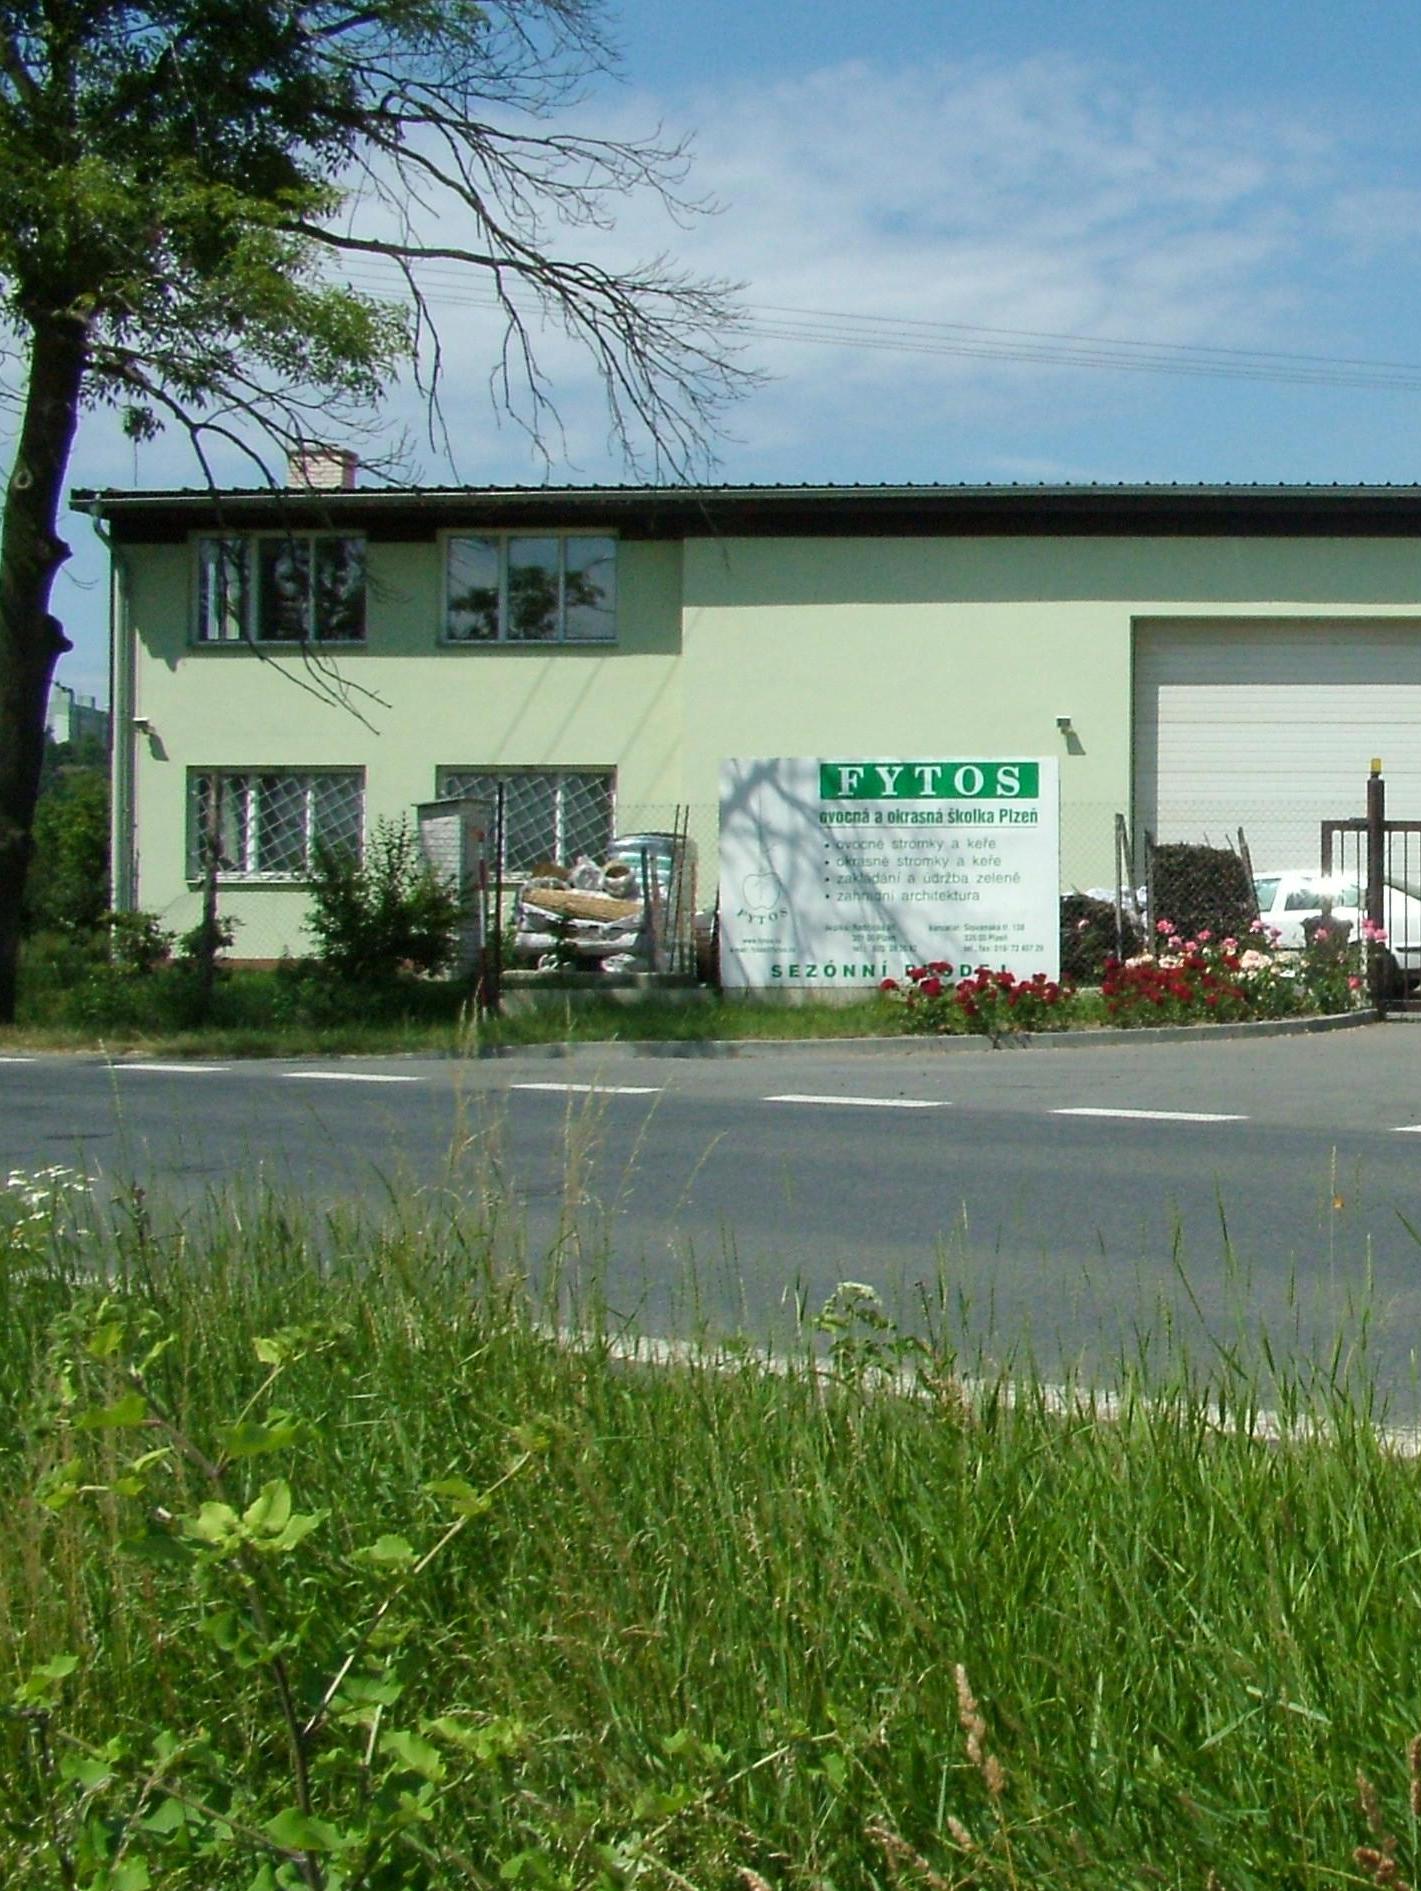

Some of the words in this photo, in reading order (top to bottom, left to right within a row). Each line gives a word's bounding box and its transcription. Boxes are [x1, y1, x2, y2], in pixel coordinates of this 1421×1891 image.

[838, 765, 1021, 797] FYTOS
[819, 807, 870, 824] ovocná
[874, 810, 883, 824] a
[887, 807, 944, 824] okrasná
[947, 807, 995, 824] školka
[999, 807, 1038, 824] Plzeň
[836, 838, 885, 850] ovocné
[892, 838, 944, 852] stromky
[951, 840, 960, 849] a
[967, 837, 997, 850] keře
[836, 855, 889, 867] okrasné
[897, 855, 950, 869] stromky
[956, 857, 965, 867] a
[973, 854, 1002, 867] keře
[907, 874, 916, 884] a
[923, 871, 969, 884] údržba
[901, 890, 981, 901] architektura
[736, 907, 788, 925] FYTOS
[771, 960, 889, 978] SEZÓNNÍ
